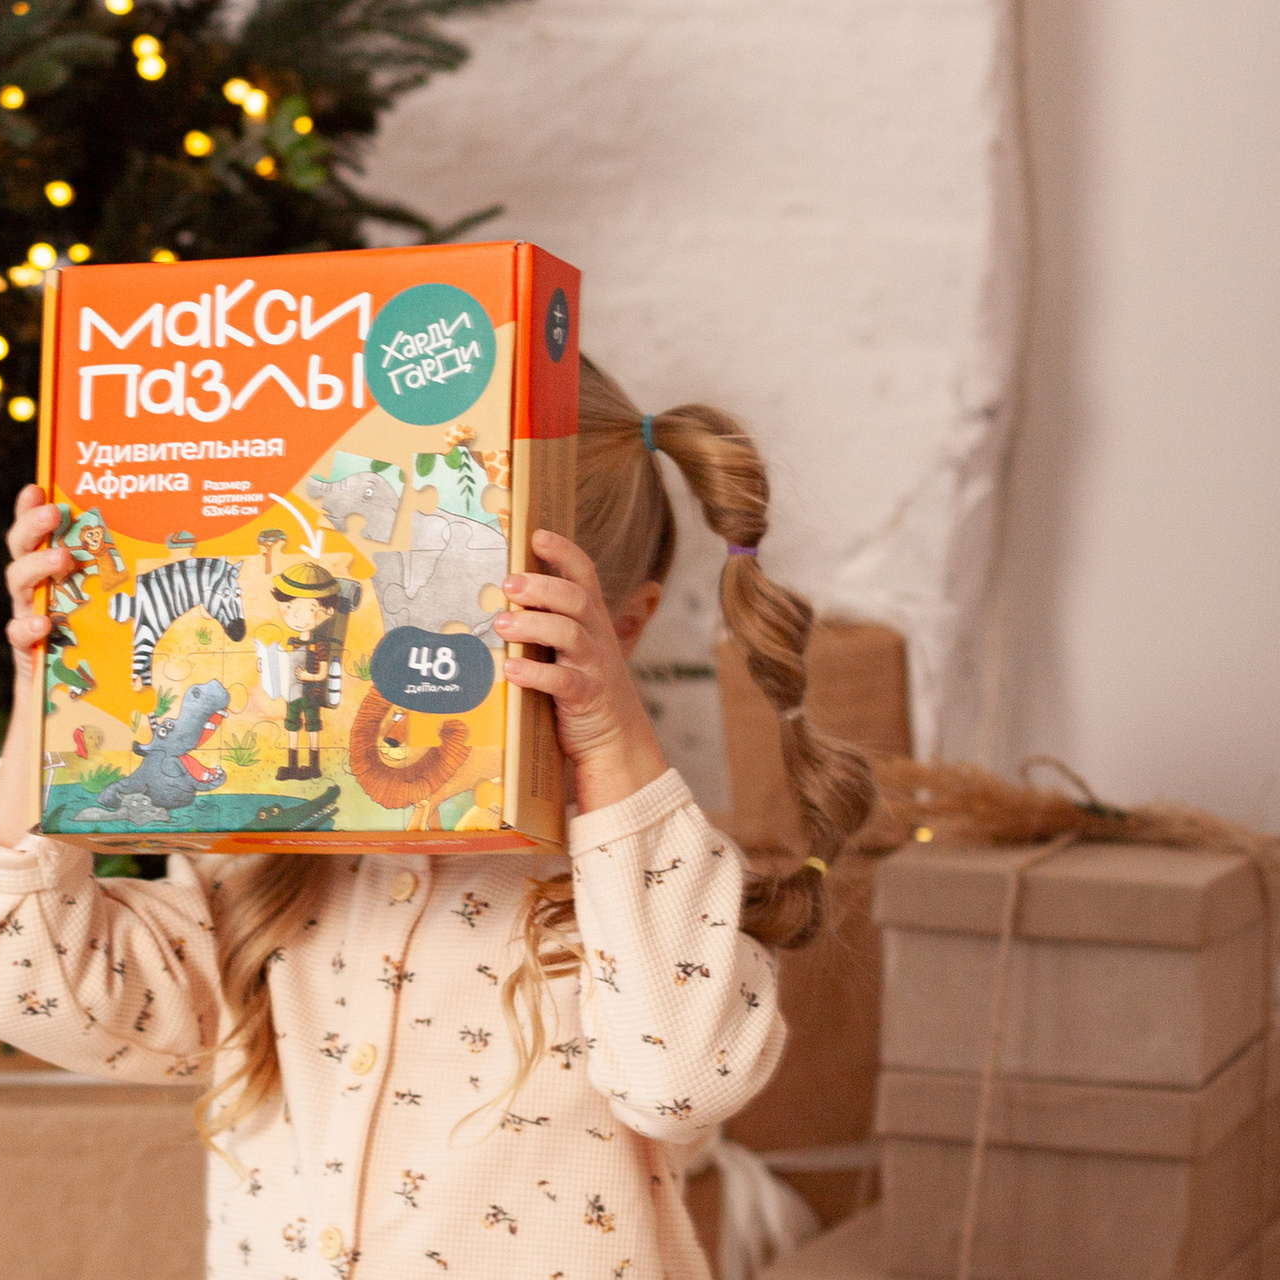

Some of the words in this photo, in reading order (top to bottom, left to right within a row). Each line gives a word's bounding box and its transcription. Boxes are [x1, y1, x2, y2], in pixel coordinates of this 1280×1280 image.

[76, 438, 286, 467] Удивительная
[76, 470, 190, 500] Африка
[203, 480, 252, 492] Размер
[202, 493, 264, 505] картинки
[240, 506, 258, 515] см
[408, 646, 457, 680] 48
